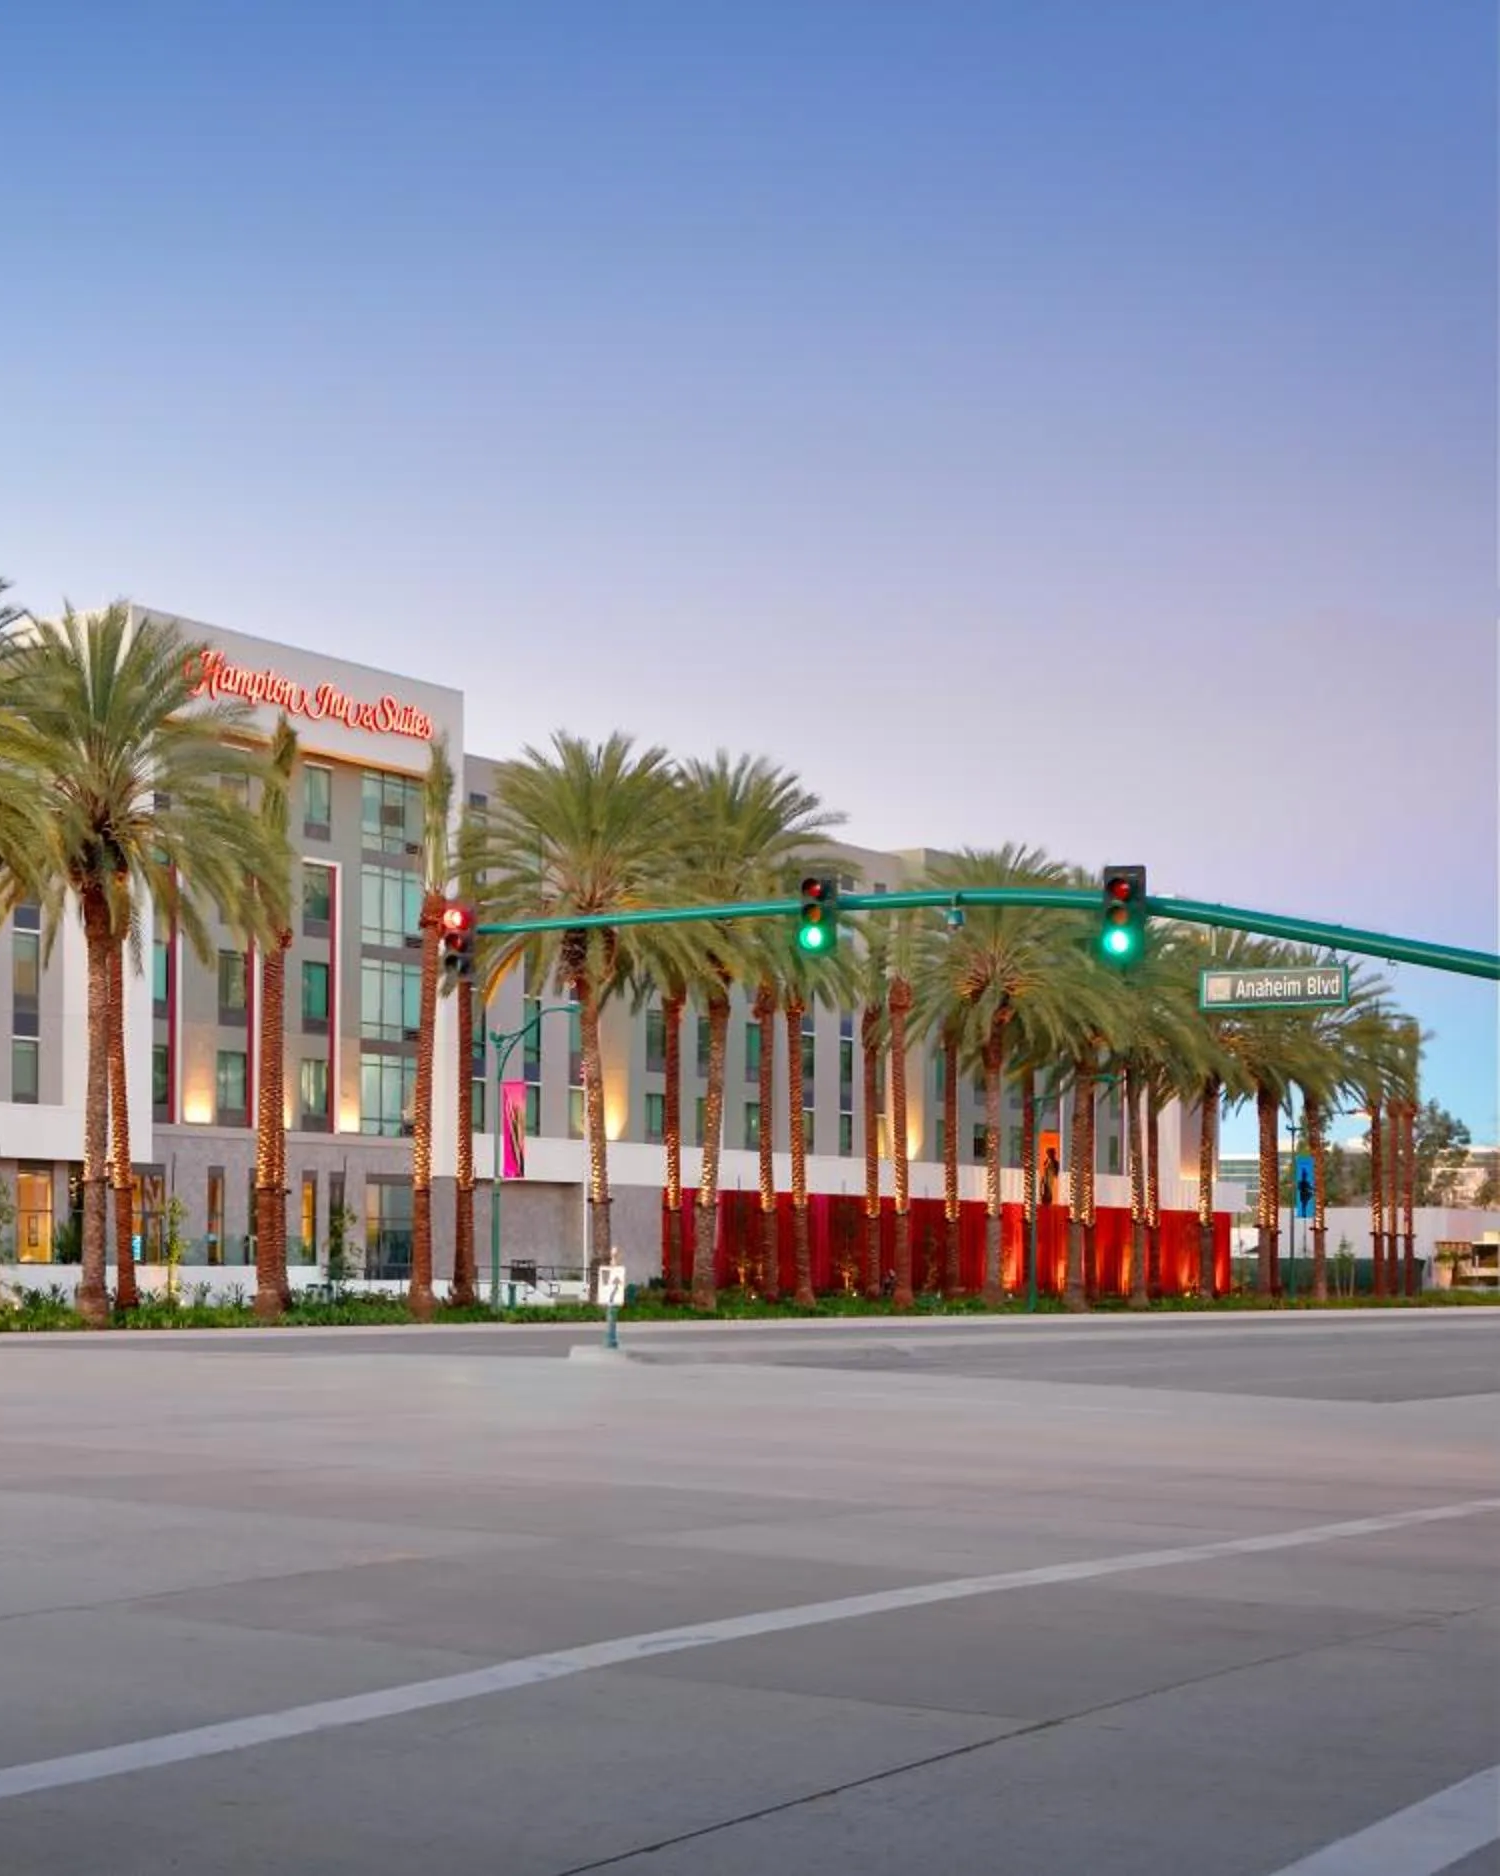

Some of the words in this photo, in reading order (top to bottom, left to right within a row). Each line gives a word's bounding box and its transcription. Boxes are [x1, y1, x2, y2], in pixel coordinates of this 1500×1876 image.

[182, 646, 306, 715] Hampton
[303, 682, 360, 727] Inn
[374, 694, 433, 740] Suites
[1236, 976, 1301, 998] Anaheim
[1307, 975, 1341, 996] Blvd
